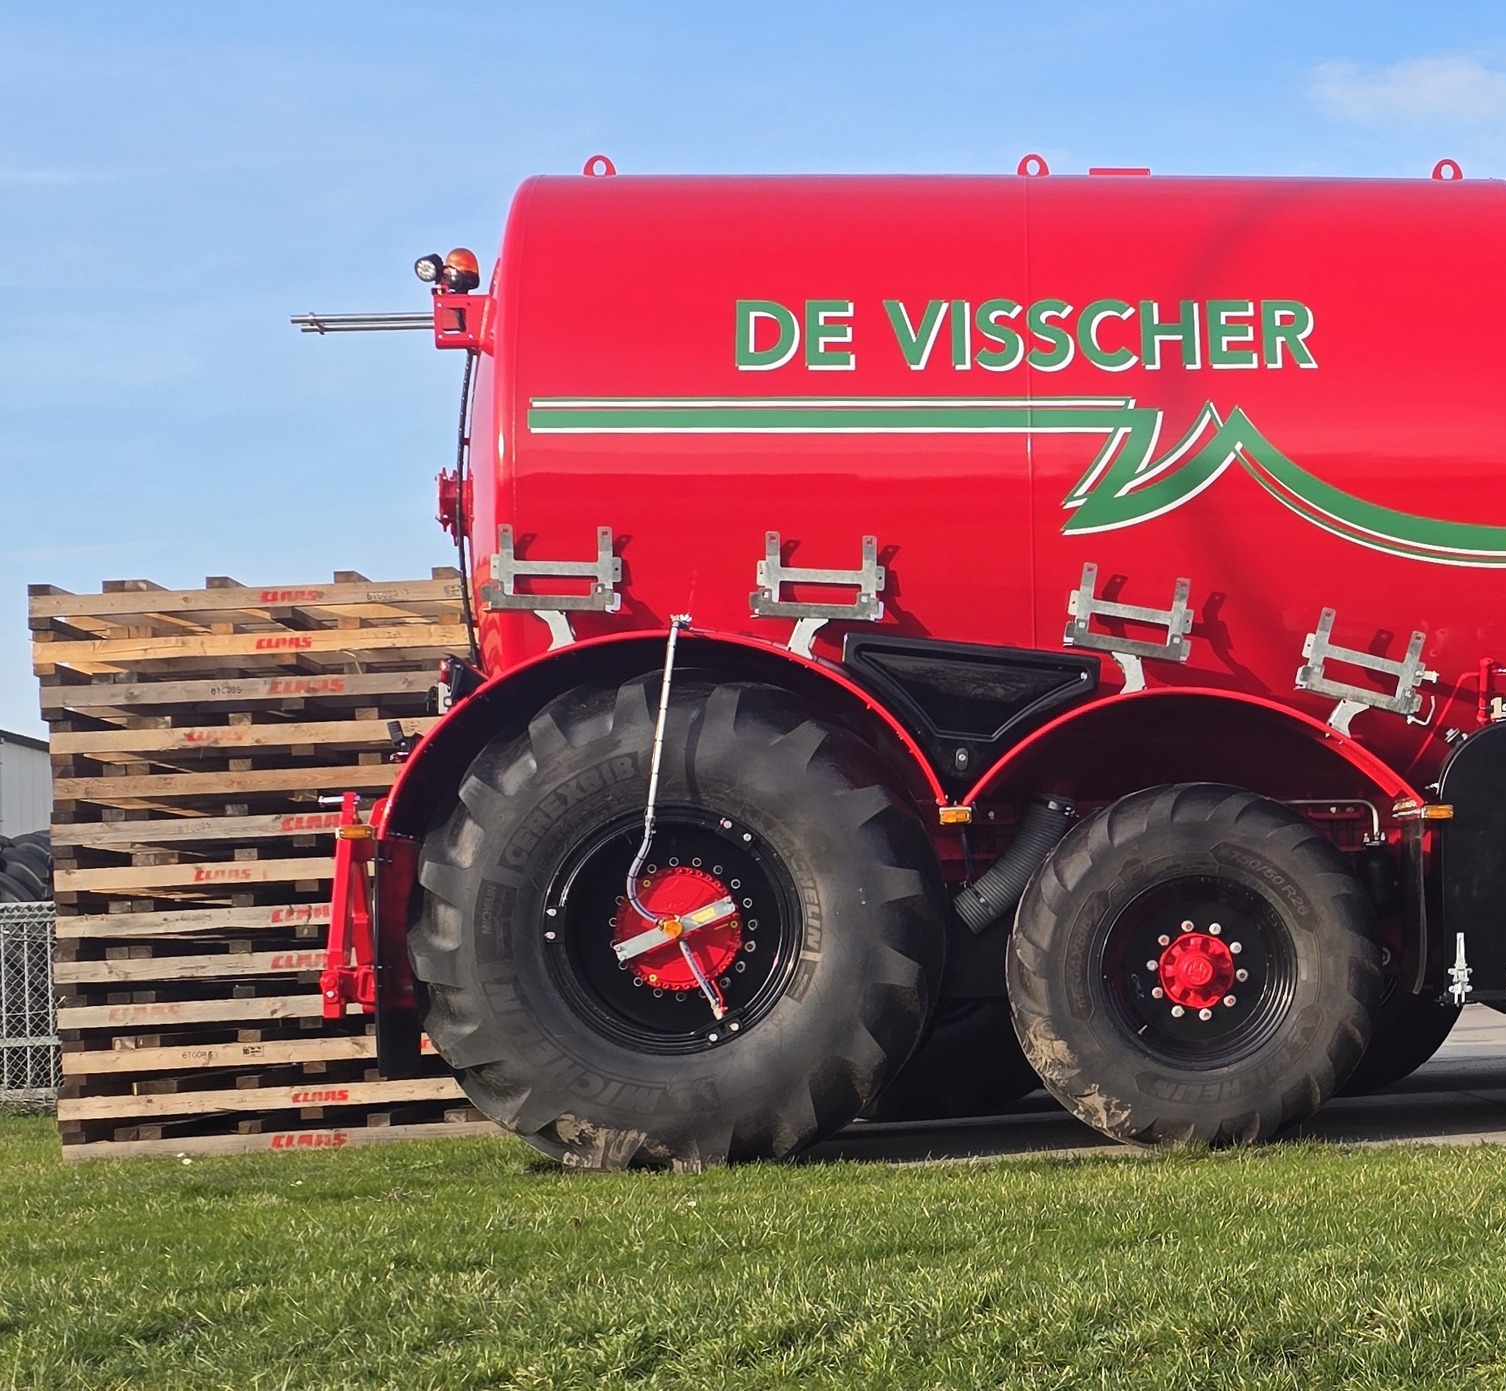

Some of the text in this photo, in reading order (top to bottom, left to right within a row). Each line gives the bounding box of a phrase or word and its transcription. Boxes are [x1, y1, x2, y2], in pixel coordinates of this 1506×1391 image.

[734, 299, 1319, 371] DE VISSCHER
[258, 590, 319, 603] CLAAS
[255, 636, 313, 650] CLAAS
[270, 678, 345, 695] CLAAS
[503, 755, 634, 866] CEREXBIB
[281, 814, 341, 832] CLAA
[193, 868, 252, 883] CLAAS
[768, 825, 823, 950] MICHELIN
[271, 905, 330, 924] CLAA
[481, 884, 498, 936] MICHELIN
[271, 953, 327, 970] CLAA
[482, 981, 664, 1114] MICHELIN
[292, 1089, 349, 1103] CLAAS
[270, 1133, 347, 1149] CLAAS
